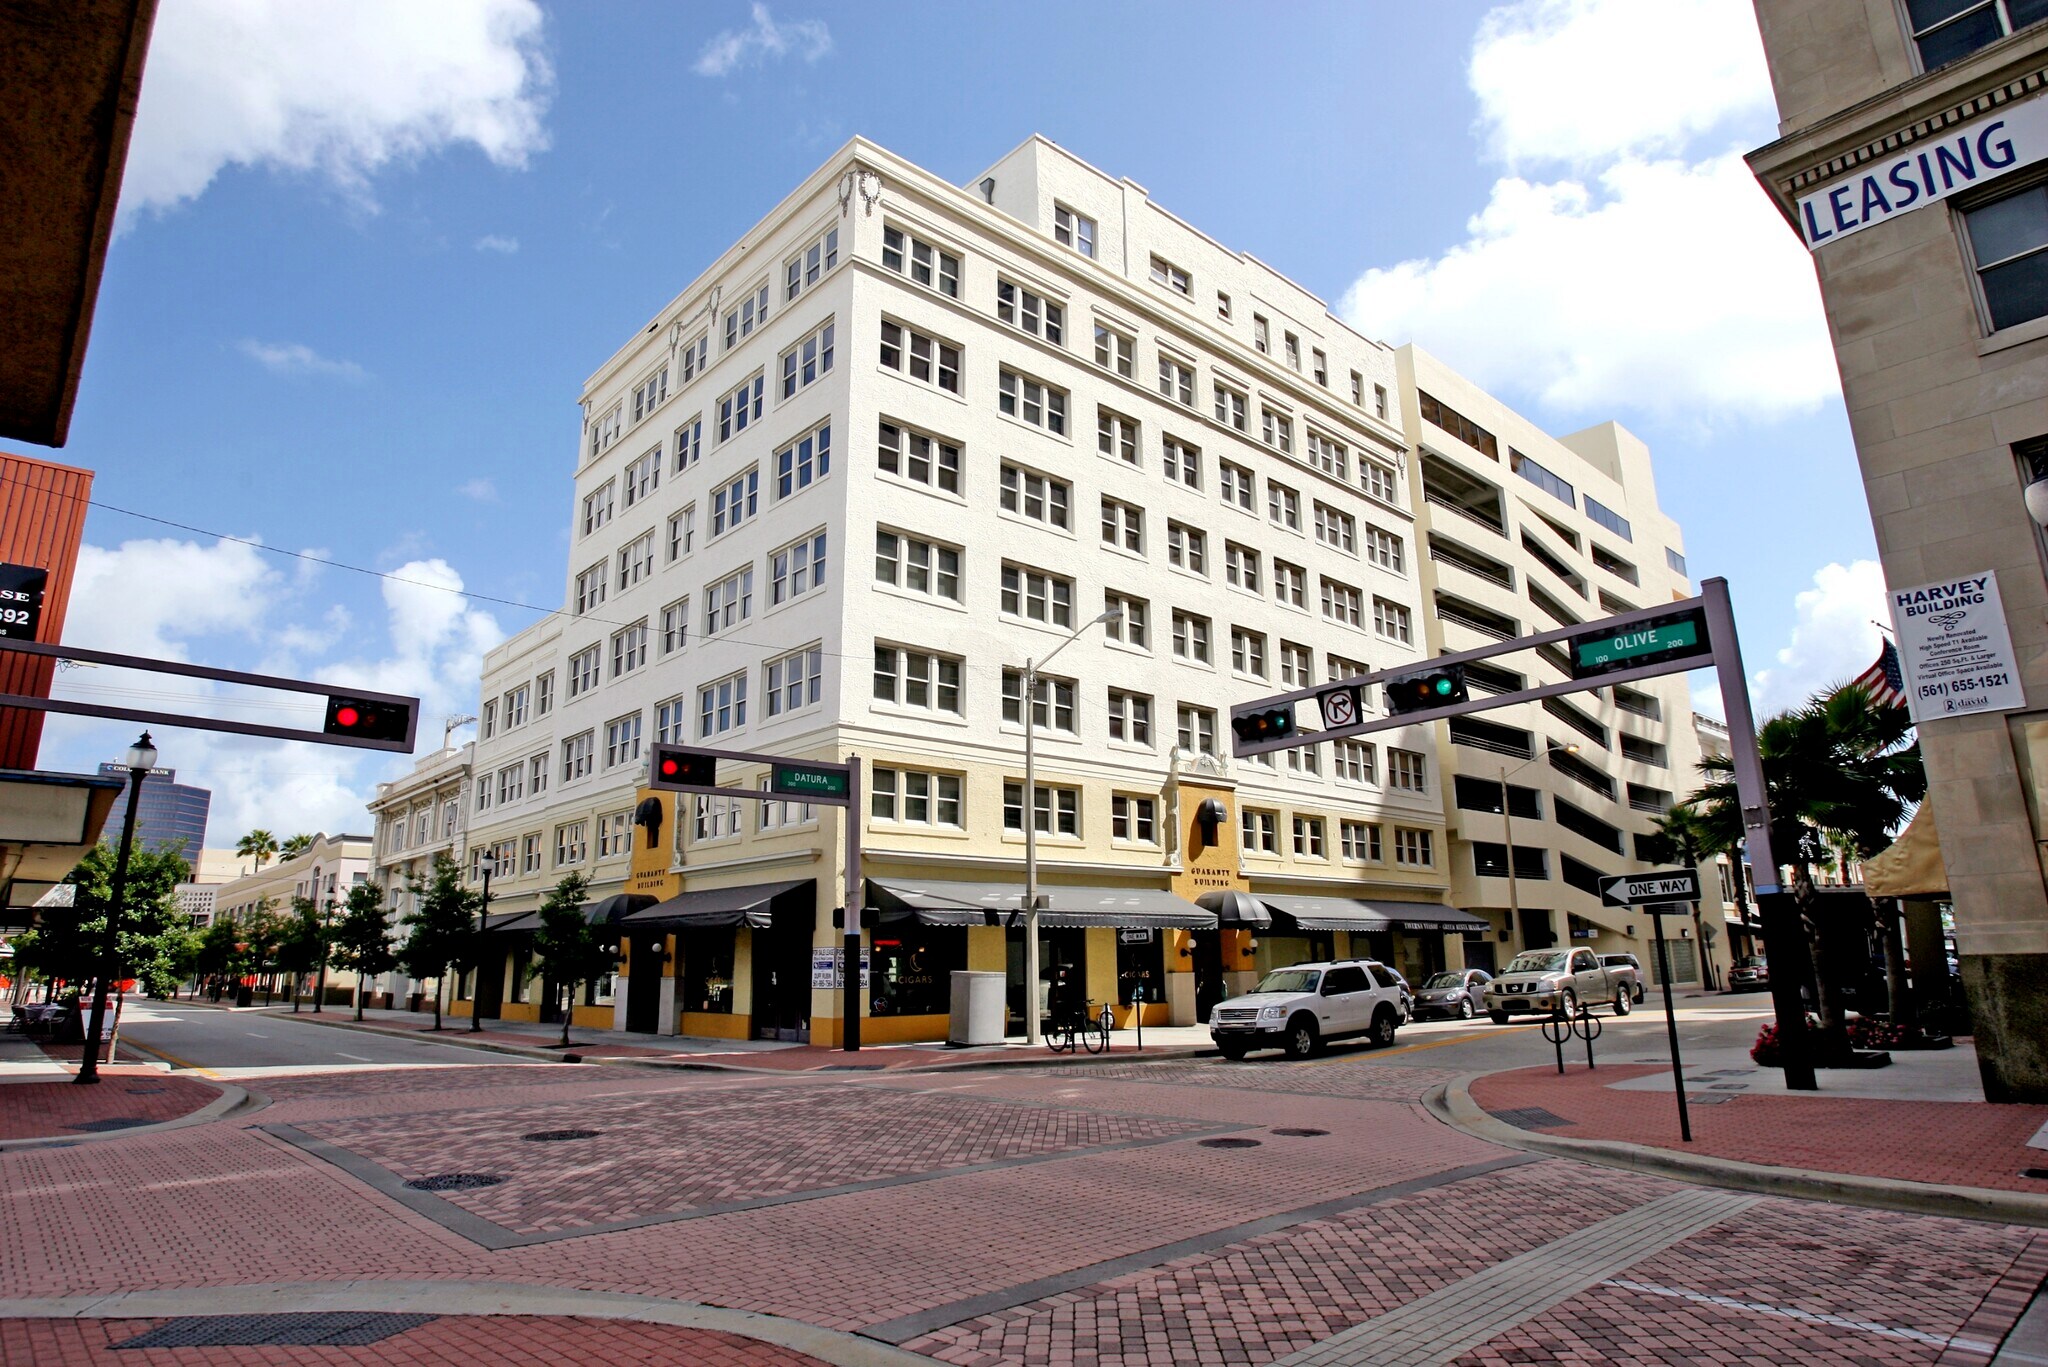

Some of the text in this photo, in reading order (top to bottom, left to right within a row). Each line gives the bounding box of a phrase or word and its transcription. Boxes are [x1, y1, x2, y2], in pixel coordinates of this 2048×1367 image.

[1803, 121, 2017, 242] LEASING
[1896, 577, 1987, 607] HARVEY
[1906, 593, 1985, 617] BUILDING
[1614, 630, 1658, 650] OLIVE
[1946, 629, 1976, 639] Renovated
[1667, 639, 1683, 648] 200
[1933, 641, 1951, 649] Speed
[1961, 635, 1988, 644] Available
[1930, 647, 1962, 656] Conference
[1595, 654, 1609, 663] 100
[1956, 666, 1974, 674] Space
[1976, 662, 2003, 671] Available
[1918, 673, 2009, 700] (561) 655-1521
[794, 772, 828, 785] DATURA
[1191, 867, 1230, 876] GUARANTY
[637, 879, 664, 889] BUILDING
[1194, 878, 1229, 887] BUILDING
[1629, 879, 1687, 896] ONE WAY
[898, 975, 934, 985] CIGARS
